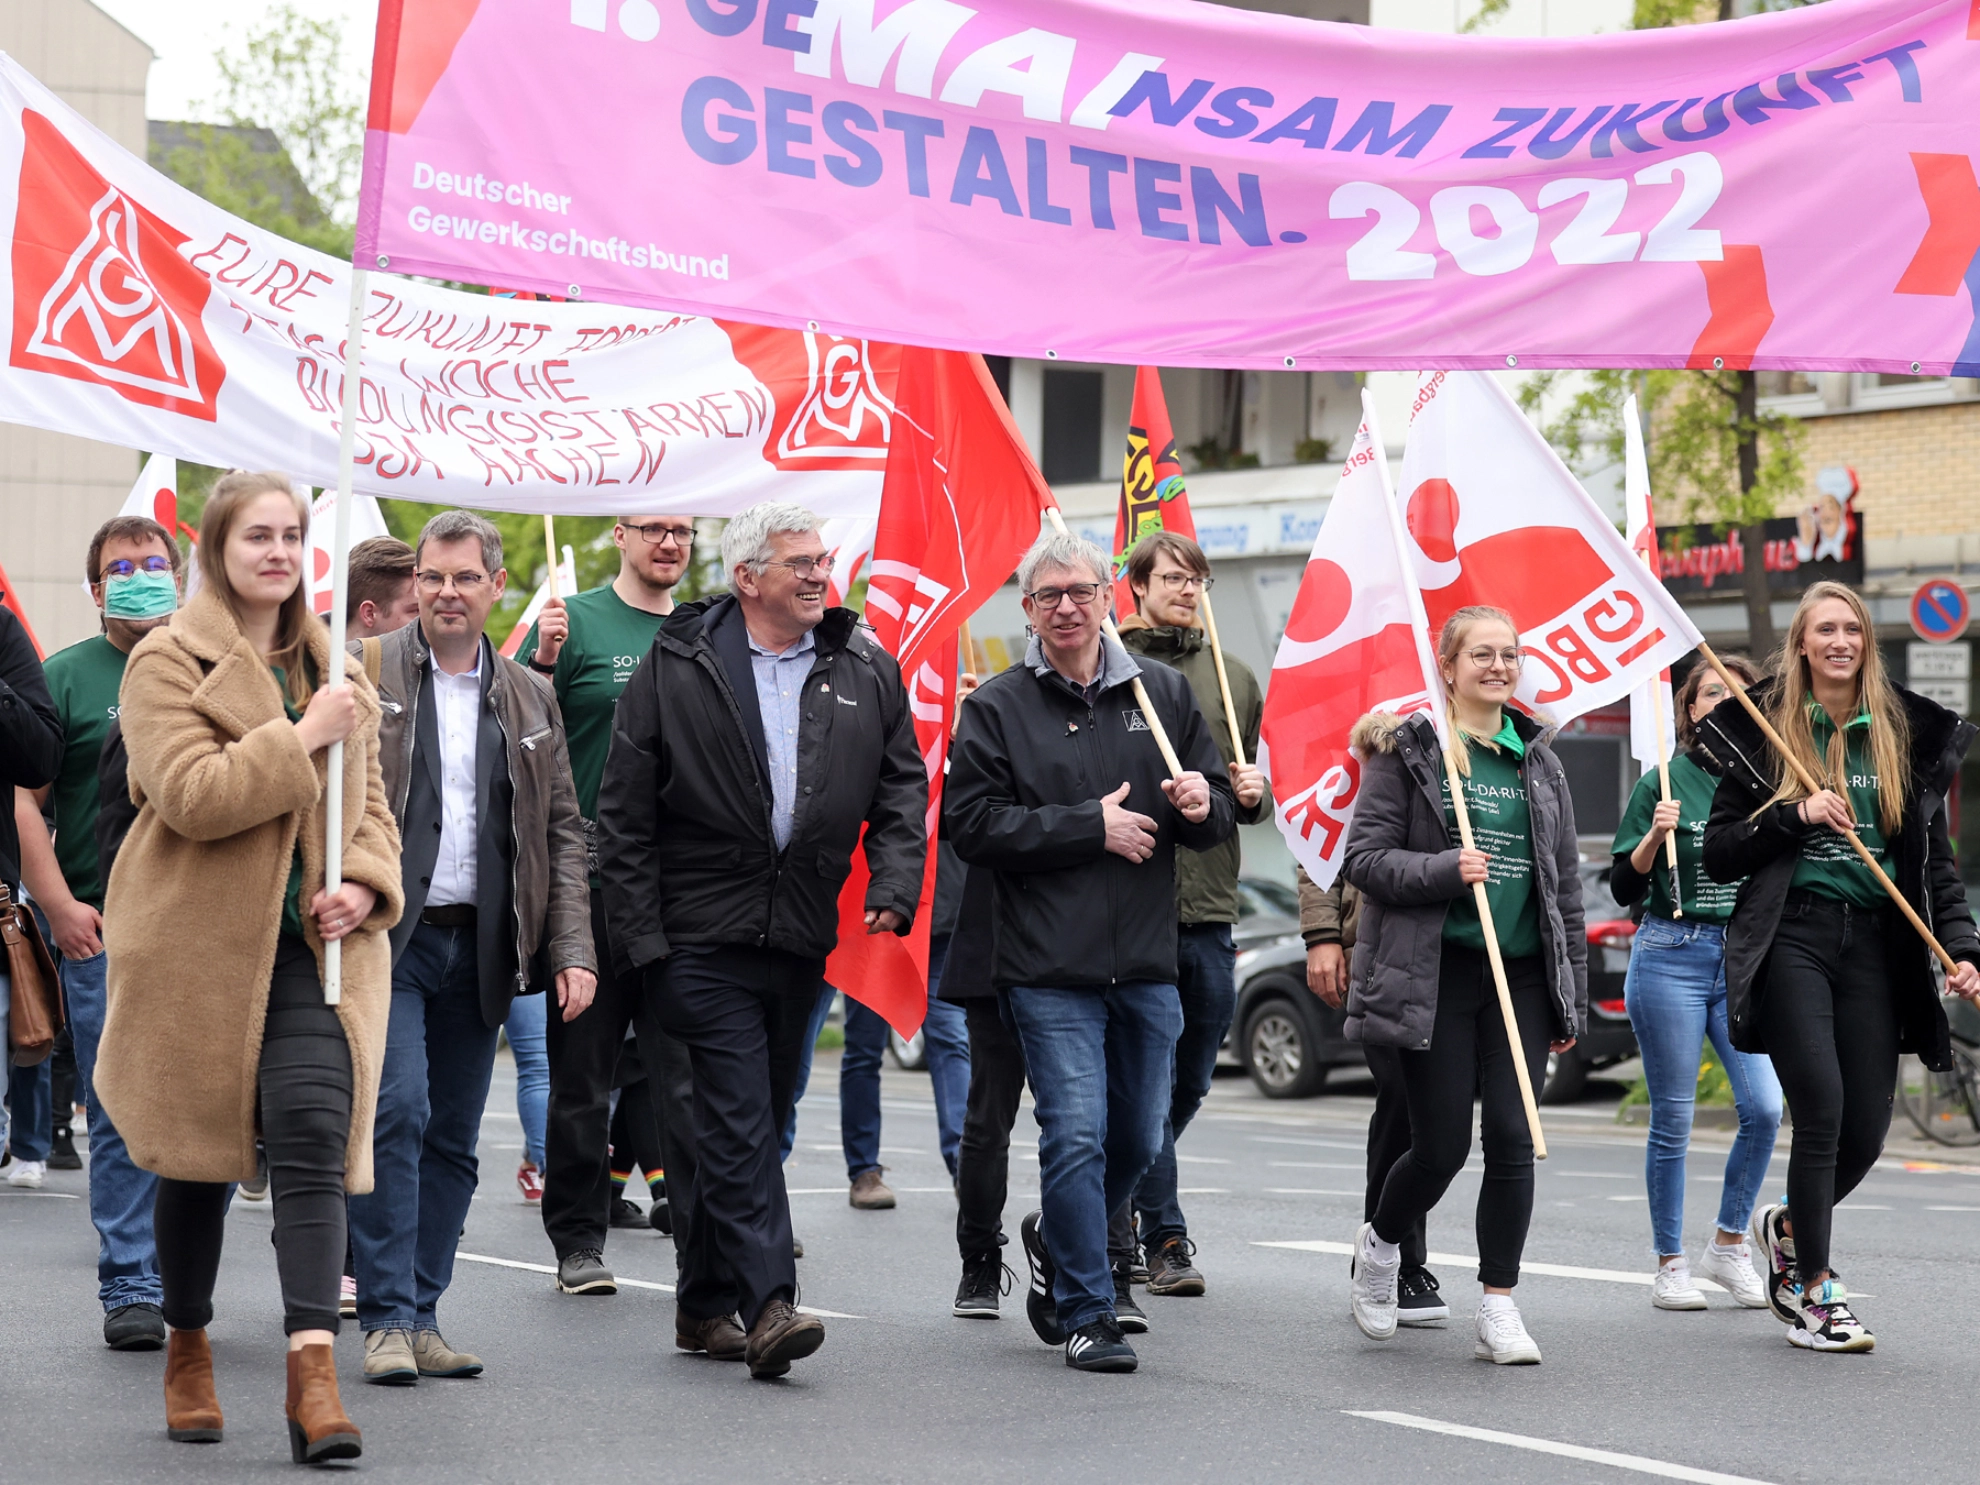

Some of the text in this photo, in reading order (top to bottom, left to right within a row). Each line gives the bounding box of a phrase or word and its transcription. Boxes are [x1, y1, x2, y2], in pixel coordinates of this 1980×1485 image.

[1461, 40, 1927, 160] ZUKUNFT
[412, 162, 572, 216] Deutscher
[681, 75, 1725, 281] GESTALTEN. 2022
[407, 206, 729, 281] Gewerkschaftsbund
[189, 232, 334, 313] EURE
[345, 290, 552, 356] ZUKUNFT
[397, 357, 590, 403] WOCHE
[466, 439, 666, 486] AACHEN
